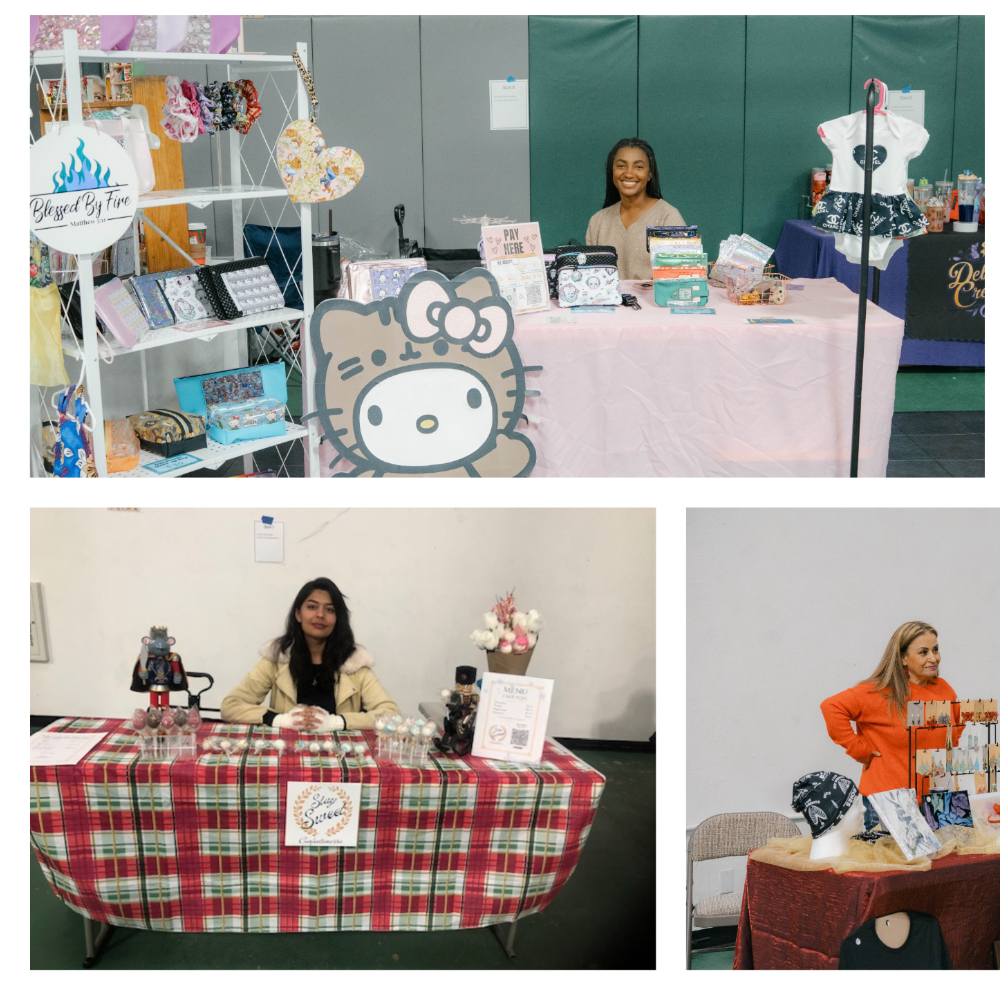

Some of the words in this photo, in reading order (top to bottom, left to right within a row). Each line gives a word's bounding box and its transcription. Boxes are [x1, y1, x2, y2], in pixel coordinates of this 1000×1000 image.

[30, 196, 81, 223] Blessed
[82, 191, 102, 218] By
[104, 189, 131, 211] Fire
[503, 228, 519, 241] PAY
[503, 242, 524, 255] HERE
[311, 793, 337, 809] Stay
[301, 803, 347, 830] Sweet
